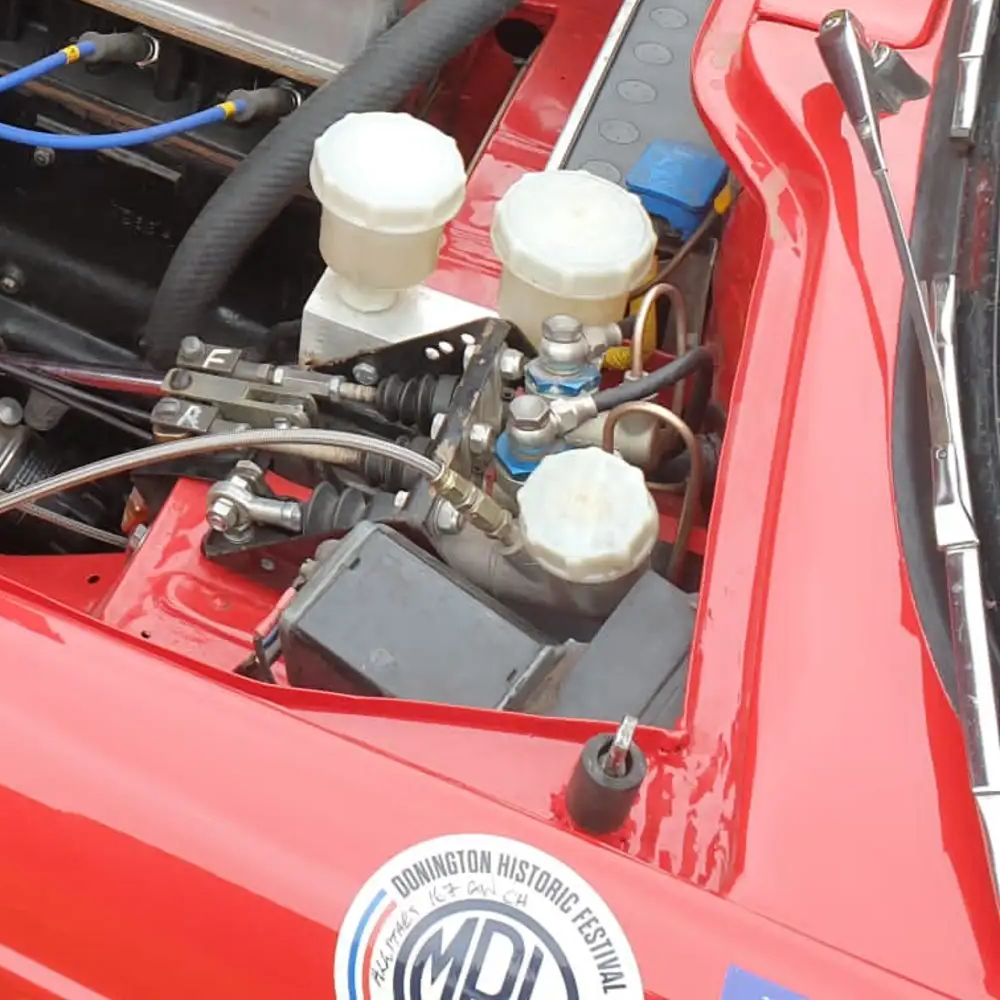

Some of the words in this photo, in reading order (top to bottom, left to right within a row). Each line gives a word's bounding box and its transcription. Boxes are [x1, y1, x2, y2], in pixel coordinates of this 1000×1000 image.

[202, 348, 232, 368] F
[391, 850, 492, 899] DONINGTON
[497, 853, 580, 914] HISTORIC
[571, 907, 627, 995] FESTIVAL
